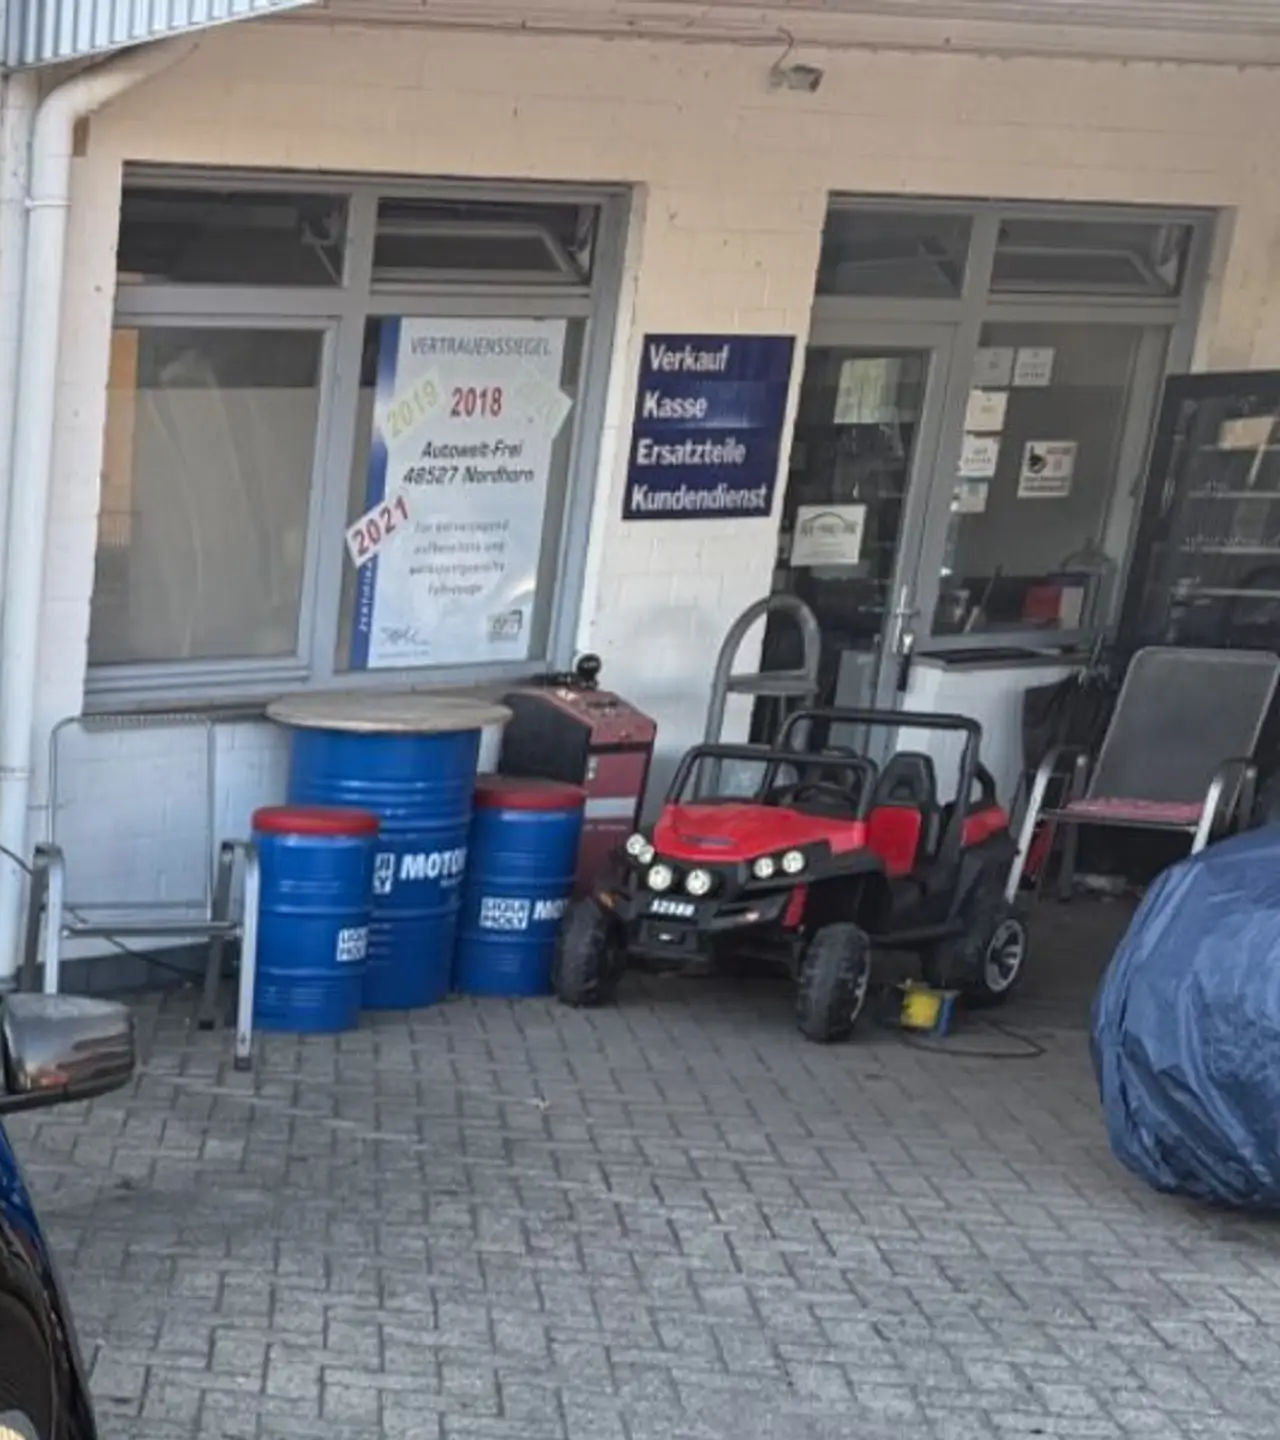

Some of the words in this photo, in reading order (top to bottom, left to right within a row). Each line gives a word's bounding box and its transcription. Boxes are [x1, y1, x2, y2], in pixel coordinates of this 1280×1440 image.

[650, 343, 731, 372] Verkauf
[449, 386, 502, 419] 2018
[642, 390, 709, 419] Kasse
[637, 436, 747, 466] Ersatzteile
[631, 482, 767, 512] Kundendienst
[352, 495, 408, 557] 2021
